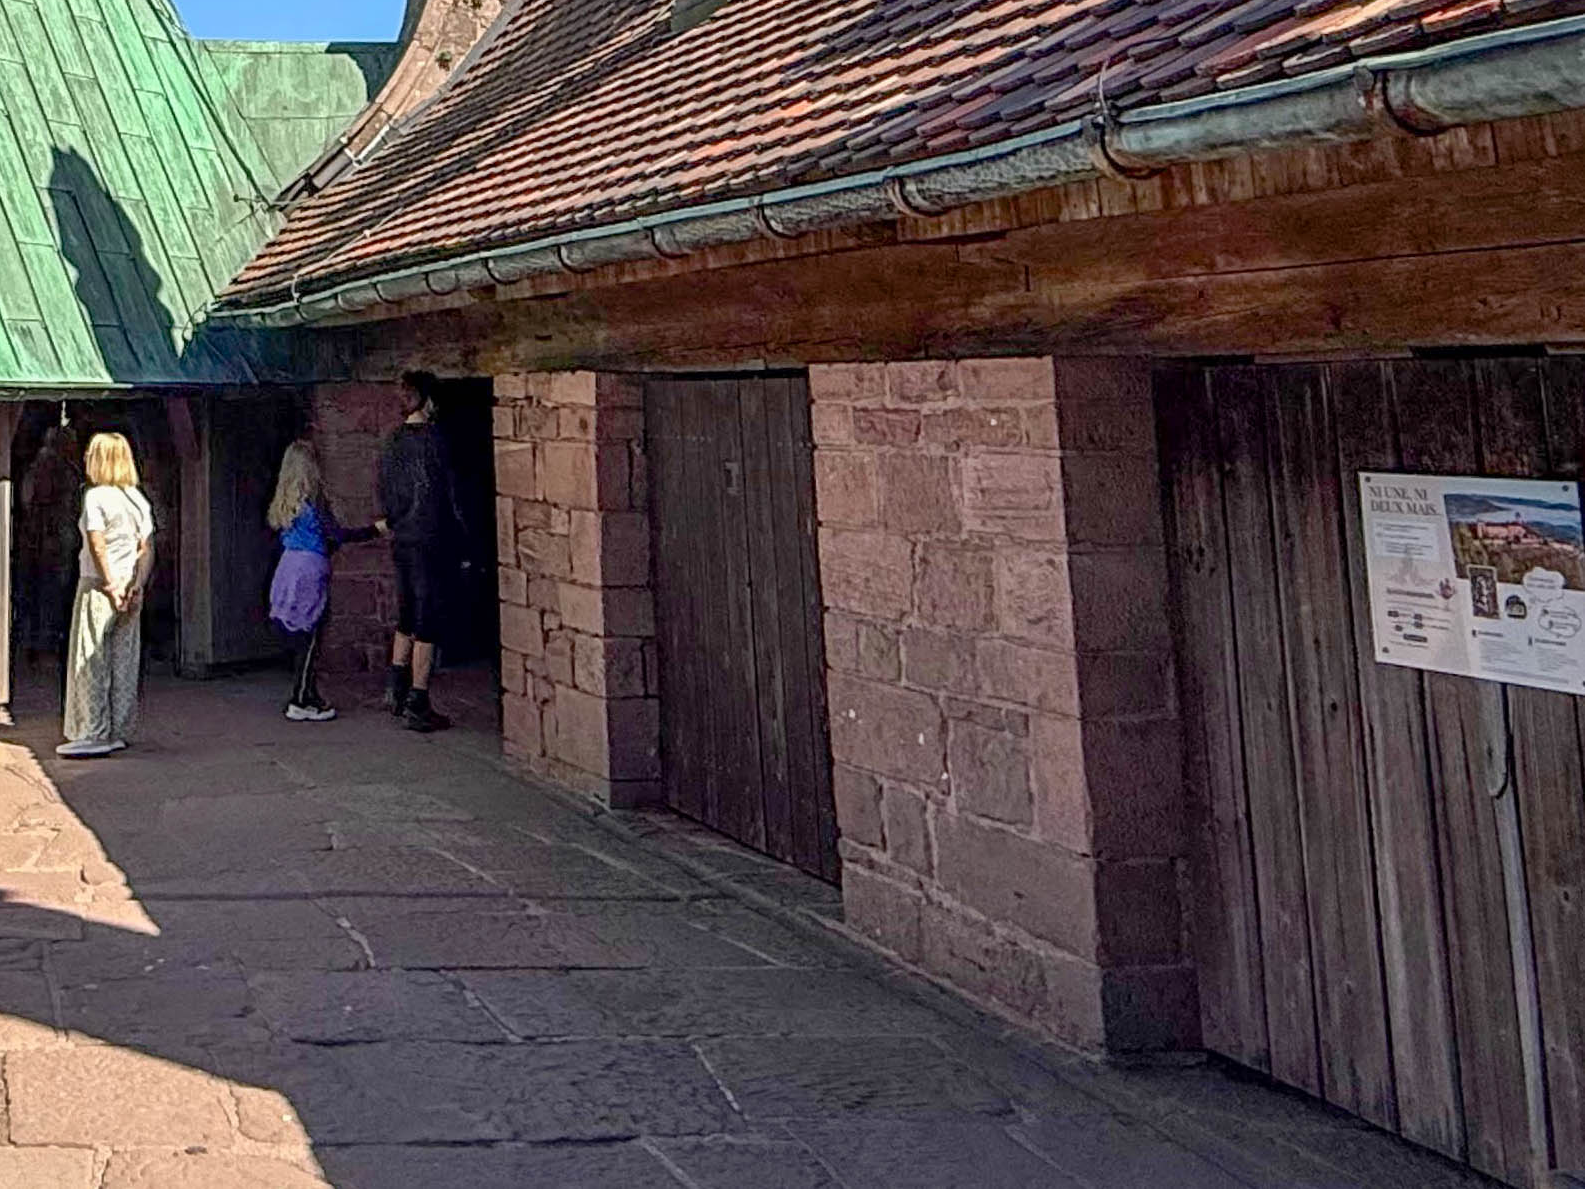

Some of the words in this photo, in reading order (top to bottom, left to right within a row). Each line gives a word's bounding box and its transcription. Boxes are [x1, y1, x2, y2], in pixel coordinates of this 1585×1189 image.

[1368, 485, 1382, 498] NI
[1414, 488, 1428, 500] NI
[1370, 499, 1404, 514] DEUX
